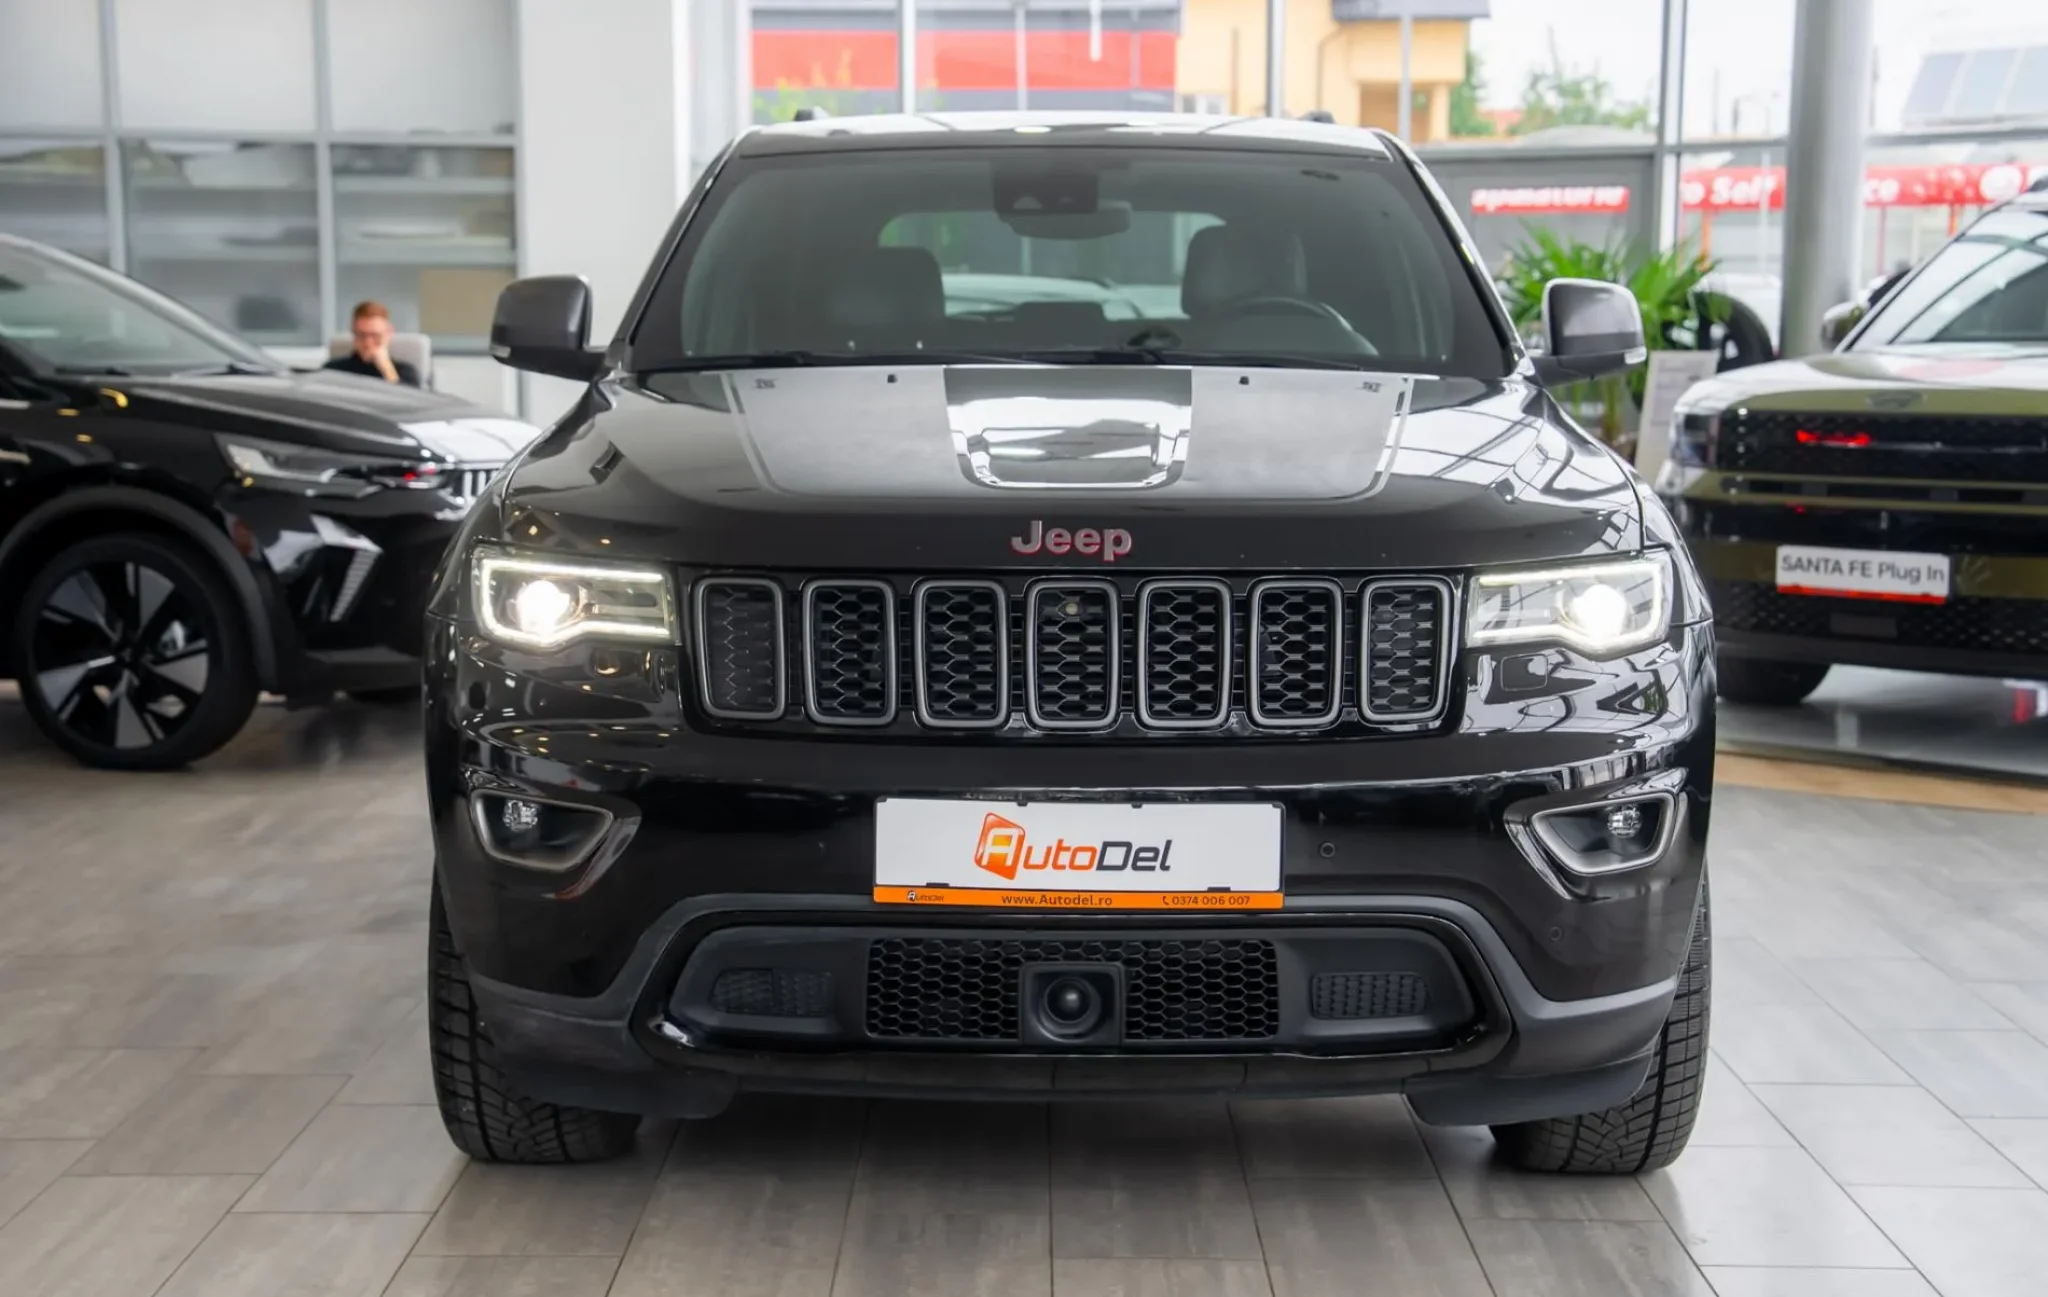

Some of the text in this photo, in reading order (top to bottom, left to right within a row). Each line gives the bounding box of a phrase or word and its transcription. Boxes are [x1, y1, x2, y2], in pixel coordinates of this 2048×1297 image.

[1010, 520, 1132, 562] Jeep
[1781, 554, 1945, 586] SANTA FE Plug In
[977, 824, 1173, 874] AutoDel
[1001, 893, 1113, 906] www.Autodel.ro
[1172, 895, 1199, 906] 0374
[1203, 896, 1226, 906] 006
[1229, 896, 1251, 906] 007
